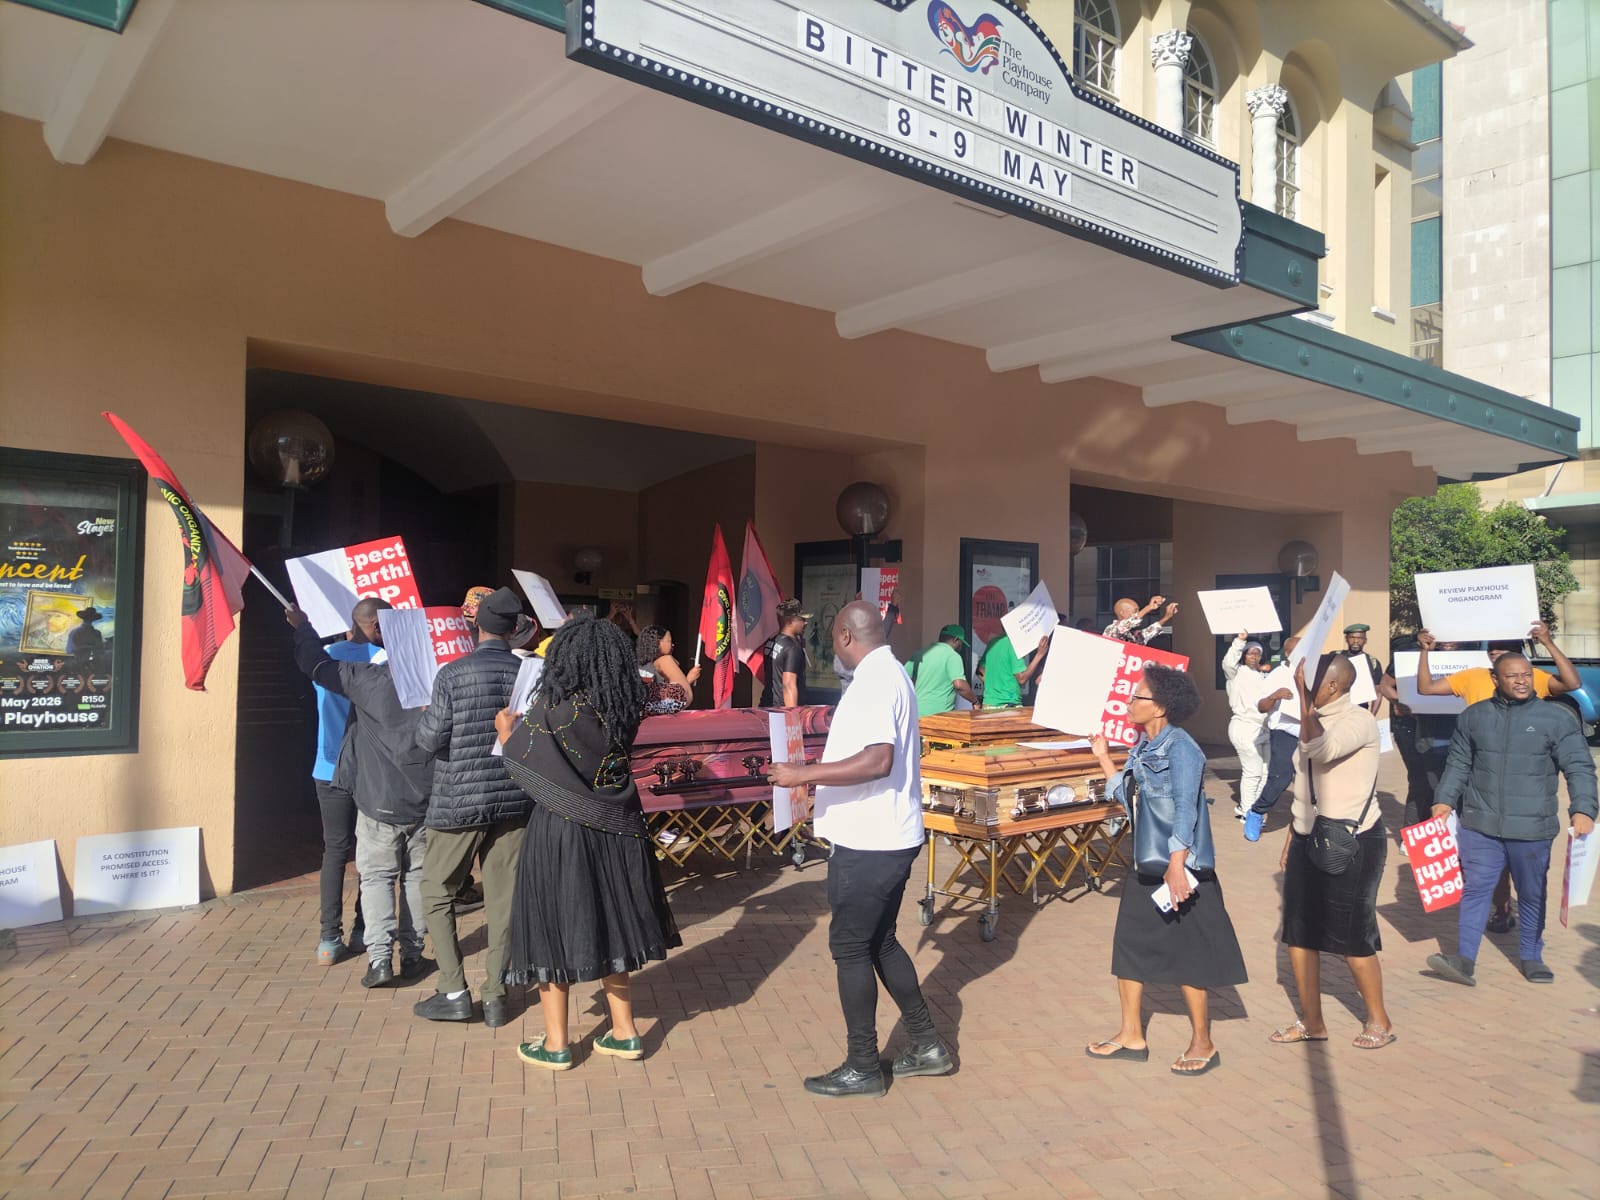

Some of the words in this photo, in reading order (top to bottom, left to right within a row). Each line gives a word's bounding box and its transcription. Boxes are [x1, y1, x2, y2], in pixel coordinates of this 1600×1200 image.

[1002, 40, 1022, 60] The
[1003, 56, 1052, 89] Playhouse
[1002, 71, 1051, 104] Company
[805, 18, 974, 117] BITTER
[1005, 106, 1135, 184] WINTER
[1004, 149, 1068, 196] MAY
[77, 520, 115, 536] Stages
[96, 517, 115, 525] New
[353, 560, 411, 588] arth!
[1439, 586, 1467, 594] REVIEW
[1468, 584, 1509, 592] PLAYHOUSE
[1447, 594, 1502, 603] ORGANOGRAM
[432, 635, 475, 656] arth!
[1, 697, 30, 709] May
[31, 696, 62, 706] 2026
[81, 695, 105, 703] R150
[5, 711, 99, 727] Playhouse
[114, 849, 169, 859] CONSTITUTION
[100, 861, 140, 870] PROMISED
[112, 872, 139, 880] WHERE
